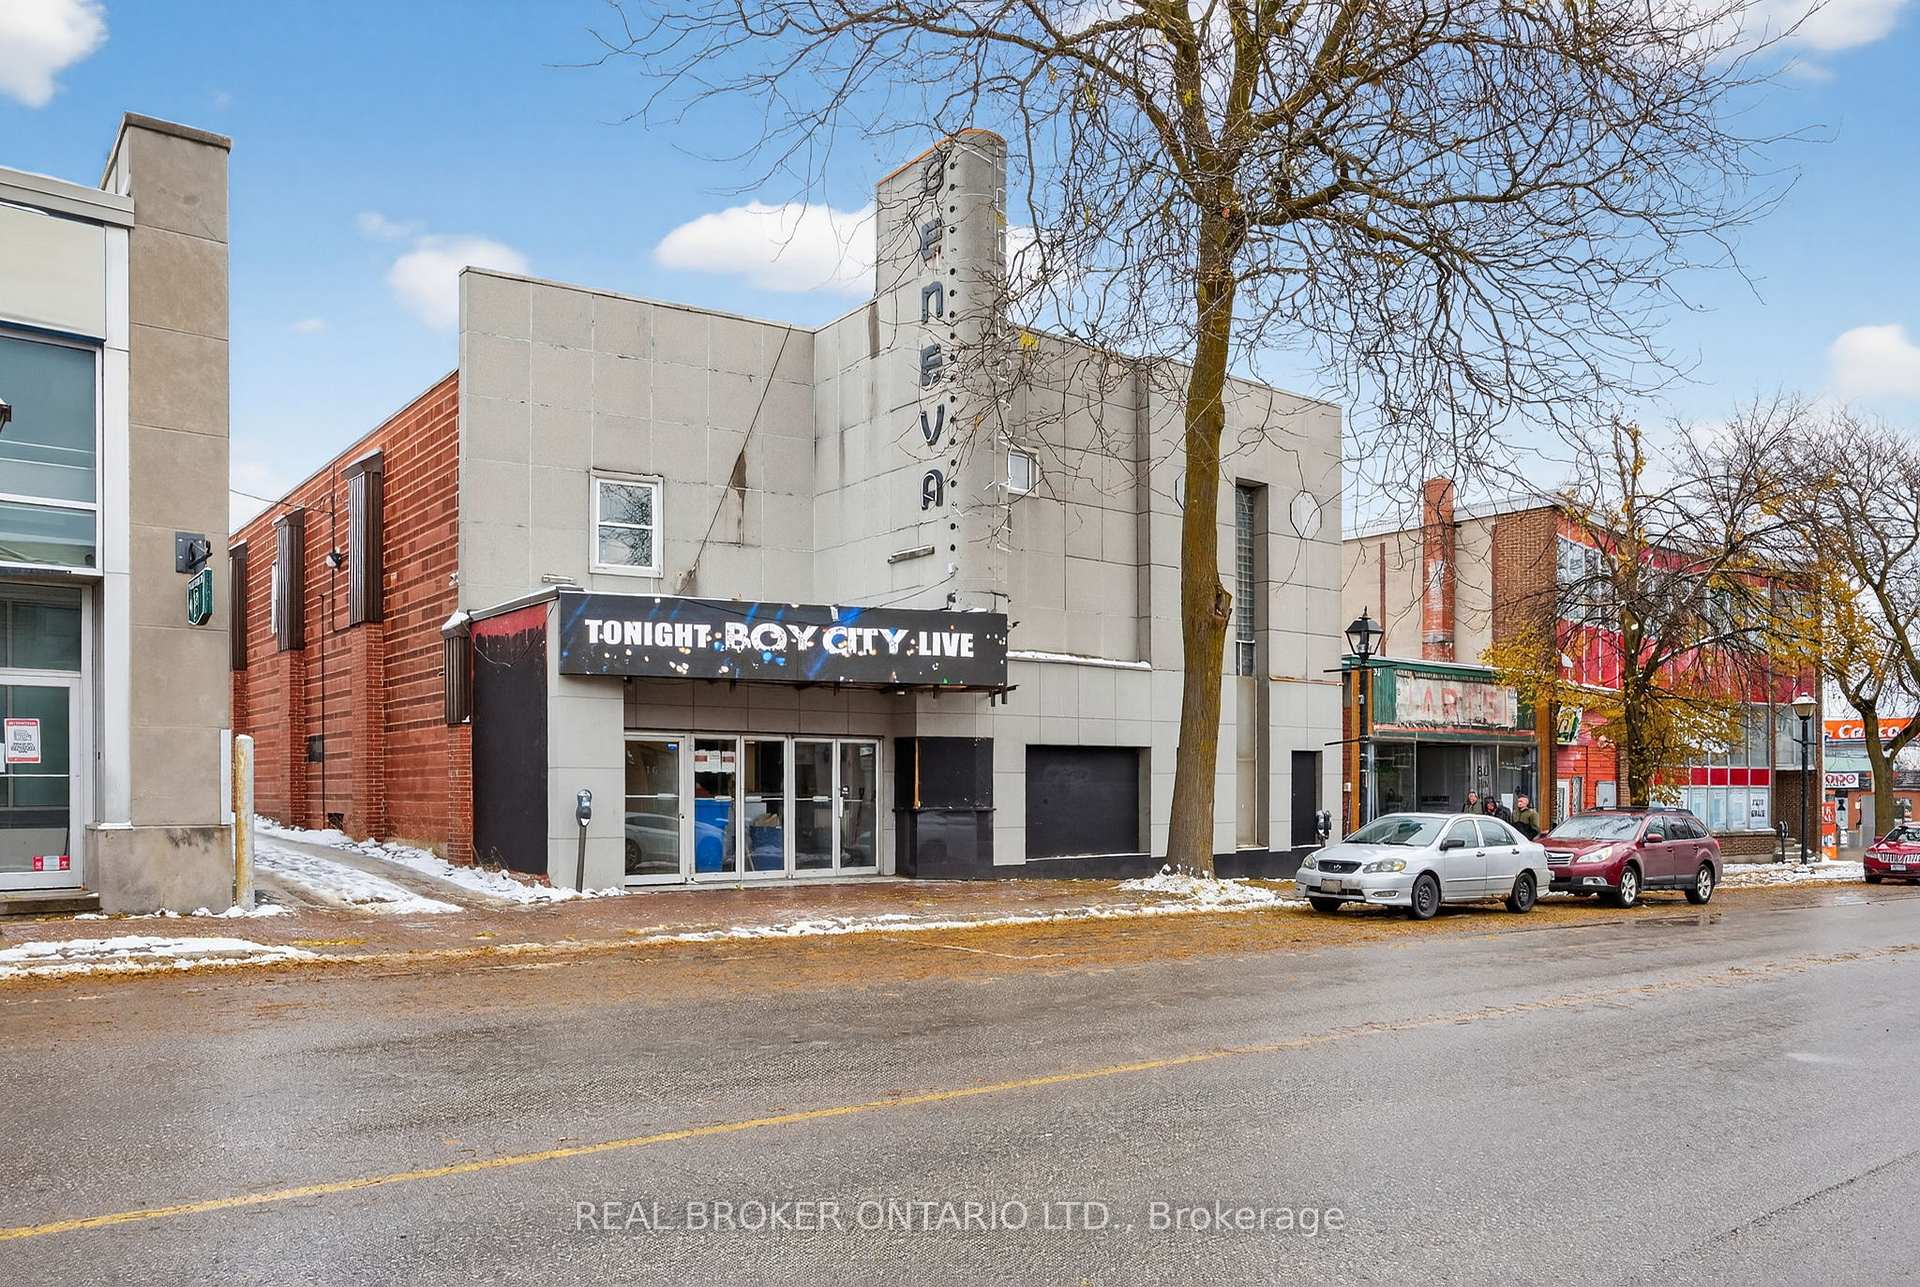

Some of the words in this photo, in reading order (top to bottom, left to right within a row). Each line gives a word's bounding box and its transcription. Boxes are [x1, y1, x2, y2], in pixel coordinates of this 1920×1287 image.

[584, 619, 711, 648] TONIGHT
[725, 621, 818, 652] BOY
[822, 626, 909, 655] CITY
[919, 631, 975, 658] LIVE
